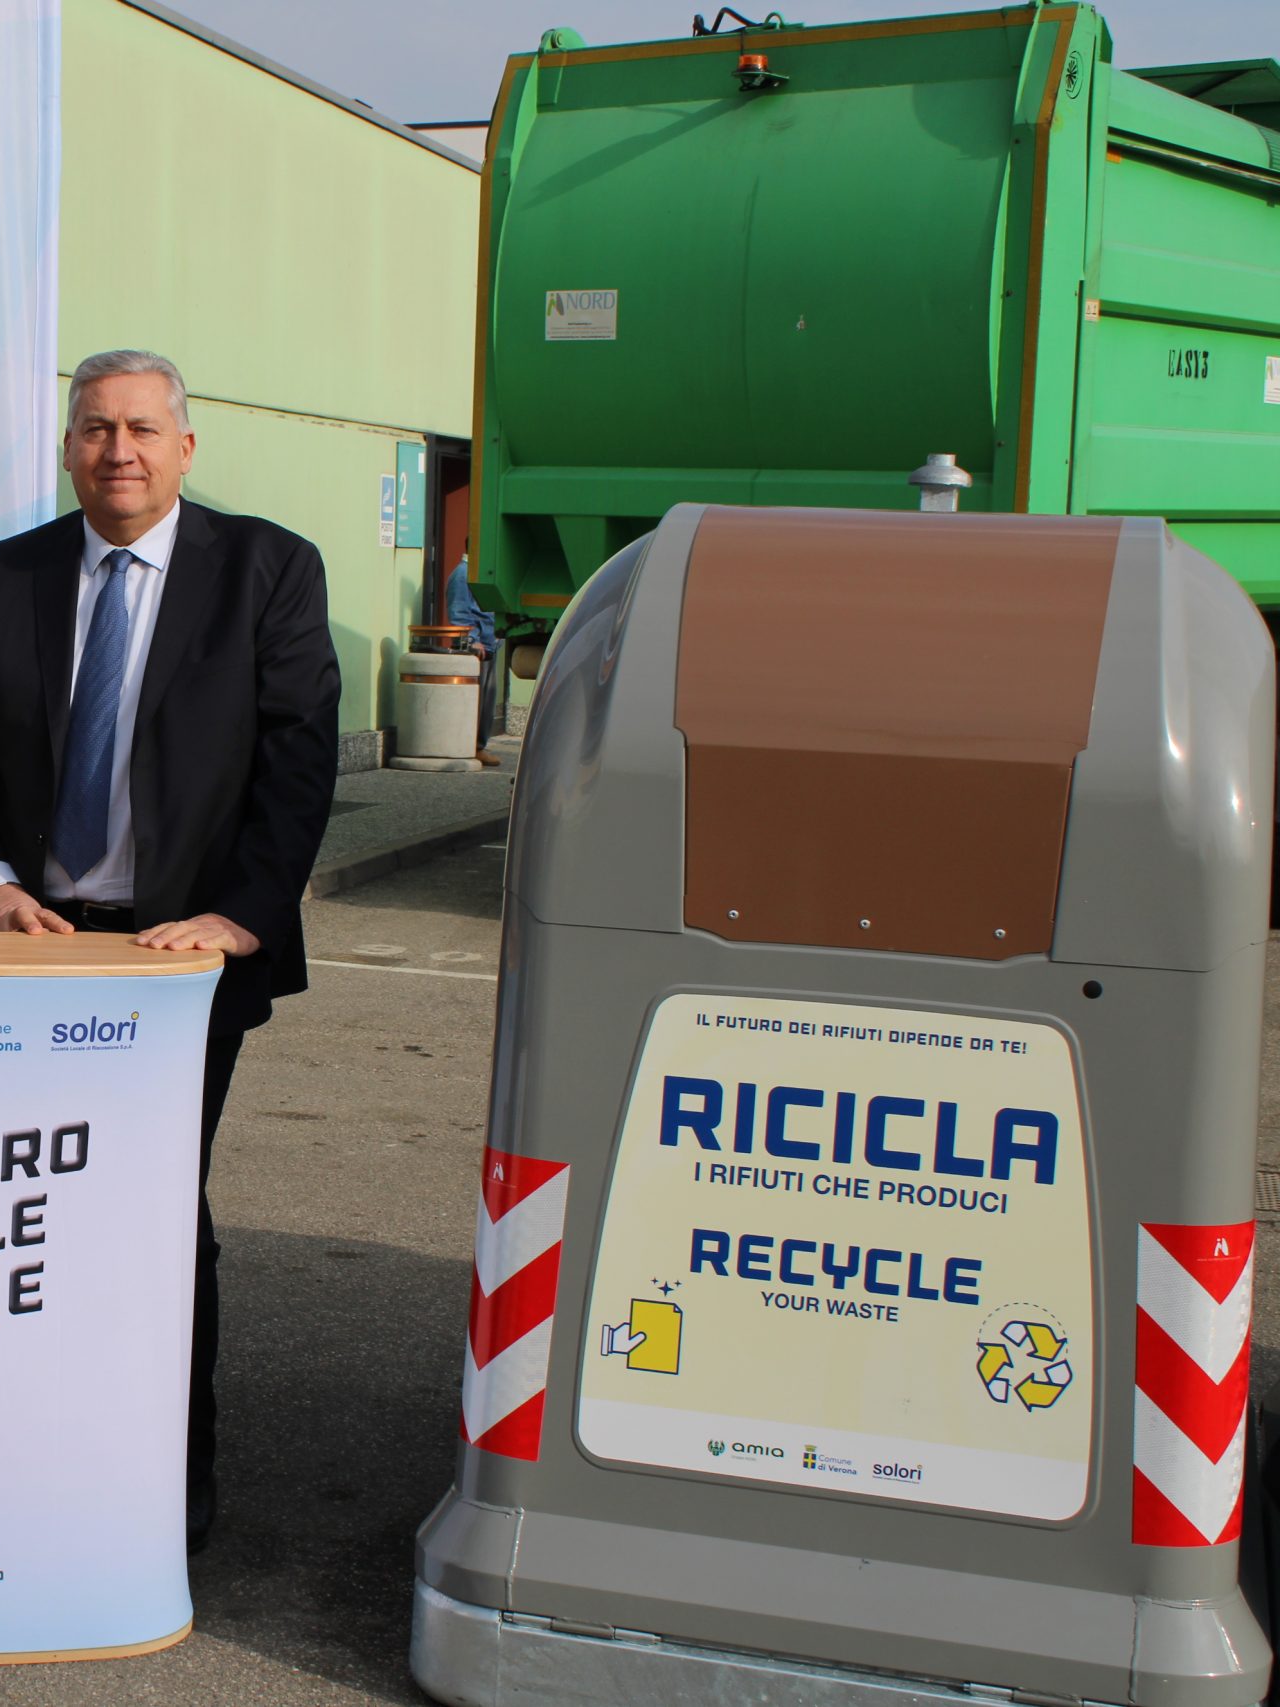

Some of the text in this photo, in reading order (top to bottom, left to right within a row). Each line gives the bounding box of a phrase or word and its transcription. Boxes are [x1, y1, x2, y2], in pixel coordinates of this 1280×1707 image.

[567, 292, 615, 310] NORD
[1168, 349, 1209, 379] EASY3
[399, 472, 407, 505] 2
[52, 1011, 139, 1043] solori
[697, 1014, 1027, 1055] IL FUTURO DEI RIFIUTI DIPENDE DA TE!
[659, 1075, 1059, 1185] RICICLA
[694, 1162, 1007, 1214] I RIFIUTI CHE PRODUCI
[690, 1228, 982, 1306] RECYCLE
[760, 1291, 899, 1322] YOUR WASTE
[732, 1442, 784, 1458] amia
[818, 1454, 852, 1466] Comune
[829, 1465, 857, 1475] Verona
[872, 1462, 923, 1481] solori
